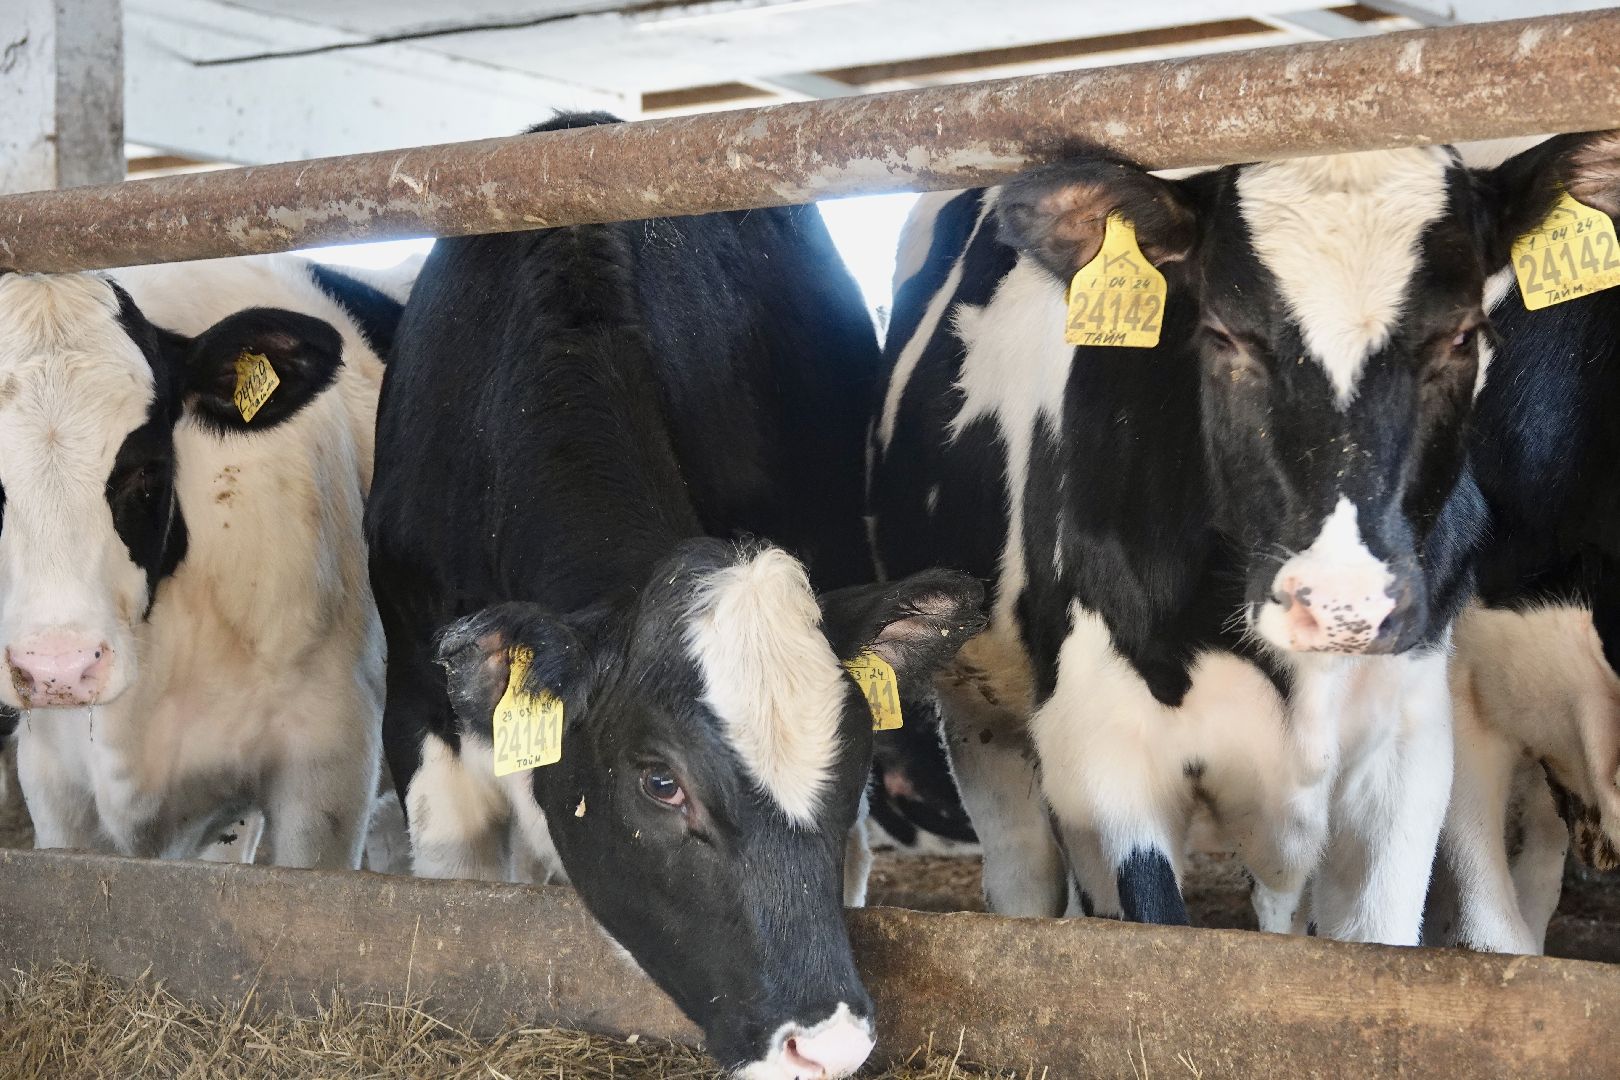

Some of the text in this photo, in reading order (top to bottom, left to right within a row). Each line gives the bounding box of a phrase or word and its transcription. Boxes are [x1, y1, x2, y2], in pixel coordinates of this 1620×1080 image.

[1552, 227, 1568, 240] 04
[1577, 218, 1592, 233] 24
[1520, 232, 1620, 294] 24142
[1109, 277, 1126, 288] 04
[1133, 280, 1151, 289] 24
[1069, 292, 1160, 332] 24142
[870, 668, 883, 680] 24
[502, 710, 513, 722] 29
[497, 713, 558, 762] 24141
